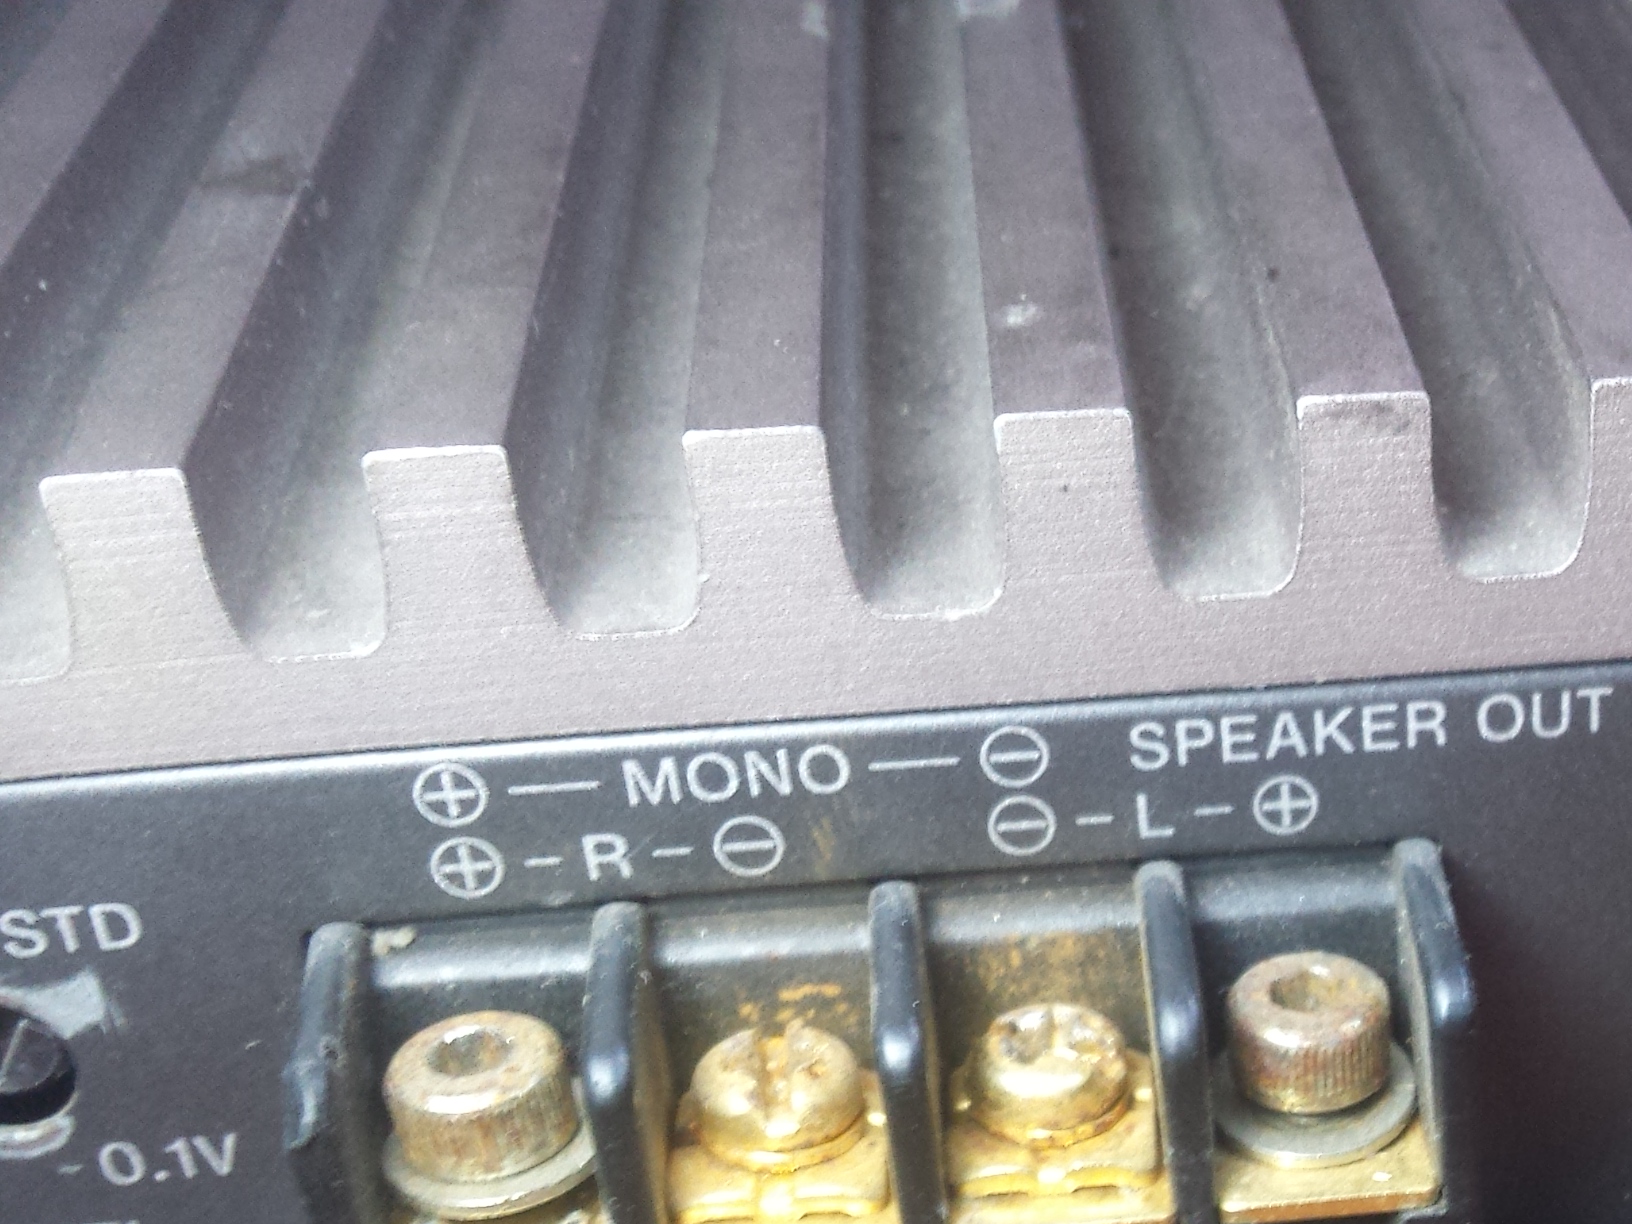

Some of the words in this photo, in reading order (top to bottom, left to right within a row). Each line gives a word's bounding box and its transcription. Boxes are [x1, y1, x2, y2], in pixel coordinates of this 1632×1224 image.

[1129, 699, 1449, 772] SPEAKER
[1476, 686, 1614, 744] OUT
[621, 743, 852, 808] MONO
[0, 902, 143, 959] STD
